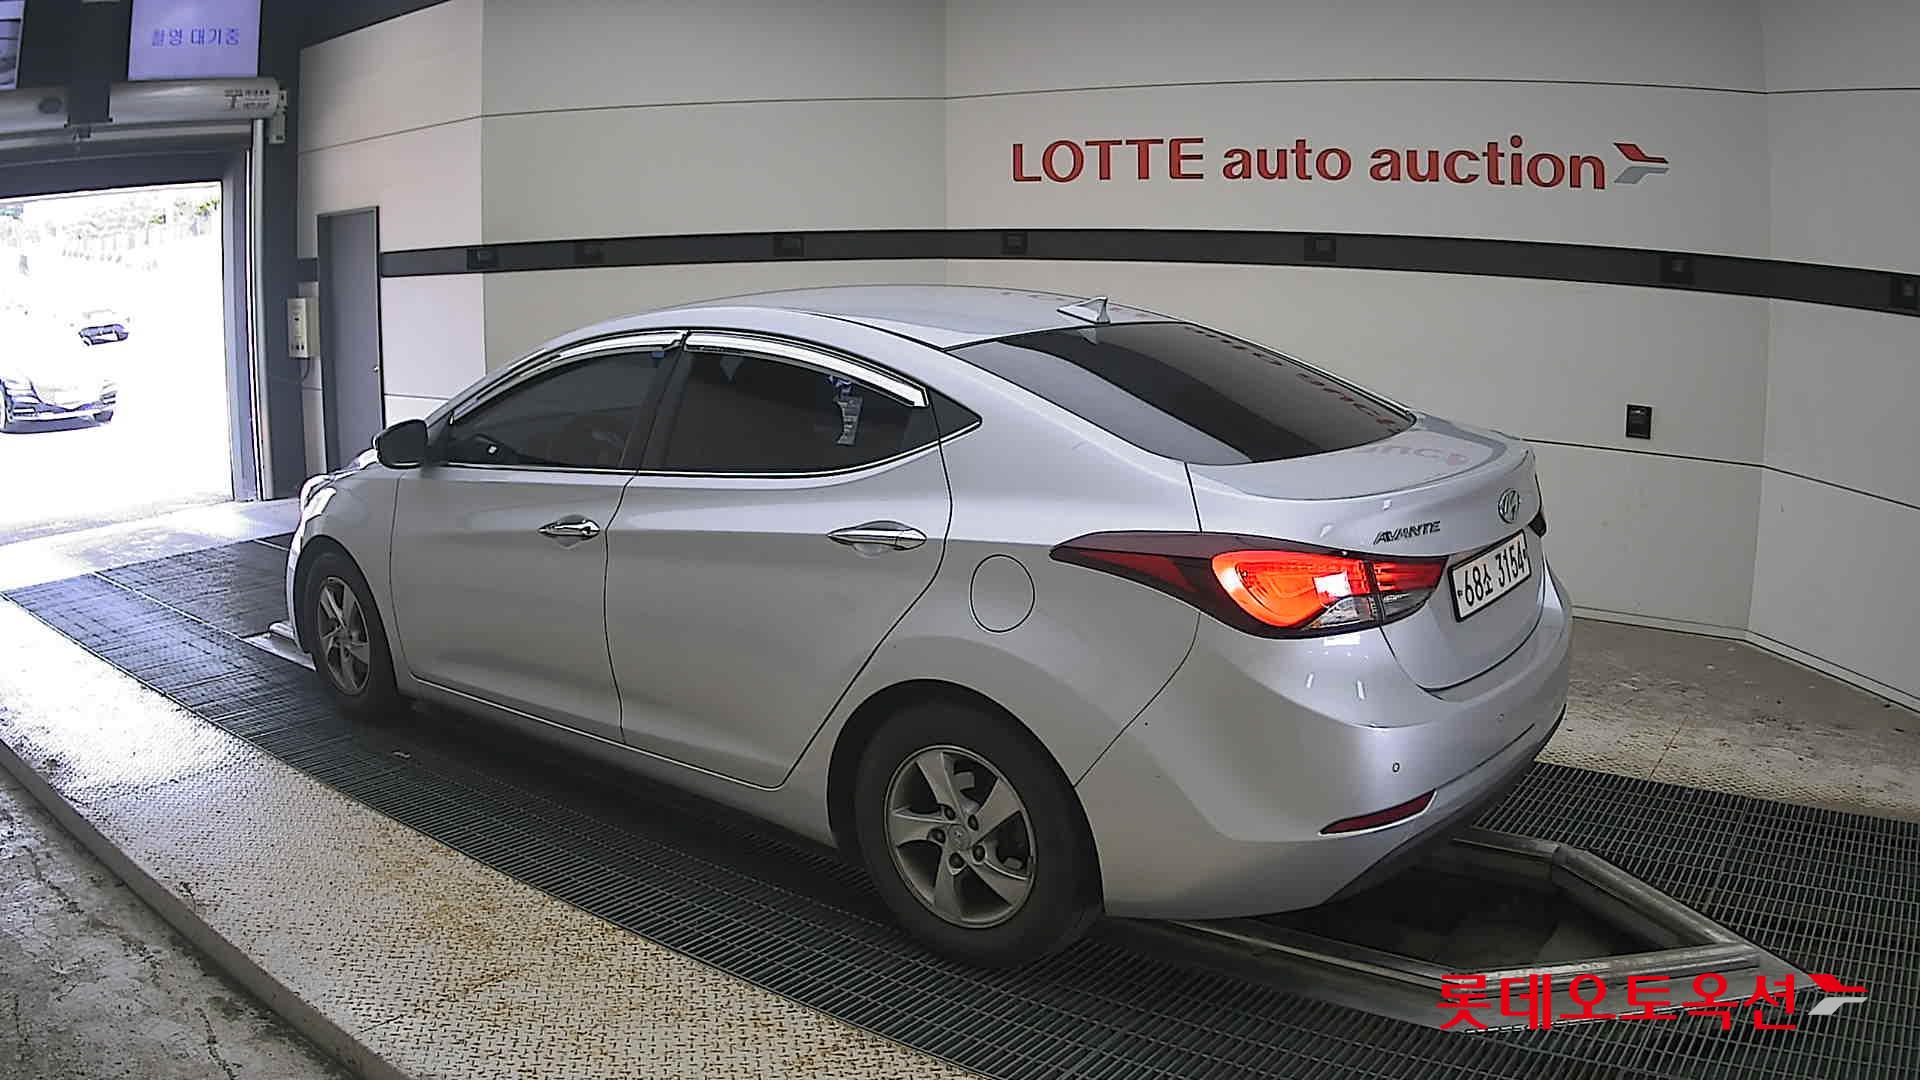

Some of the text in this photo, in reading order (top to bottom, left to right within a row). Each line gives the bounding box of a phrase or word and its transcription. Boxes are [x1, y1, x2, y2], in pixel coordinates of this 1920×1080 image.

[1012, 136, 1605, 190] LOTTE auto auction
[1373, 520, 1441, 545] AVANTE
[1464, 541, 1525, 607] 68소 3154
